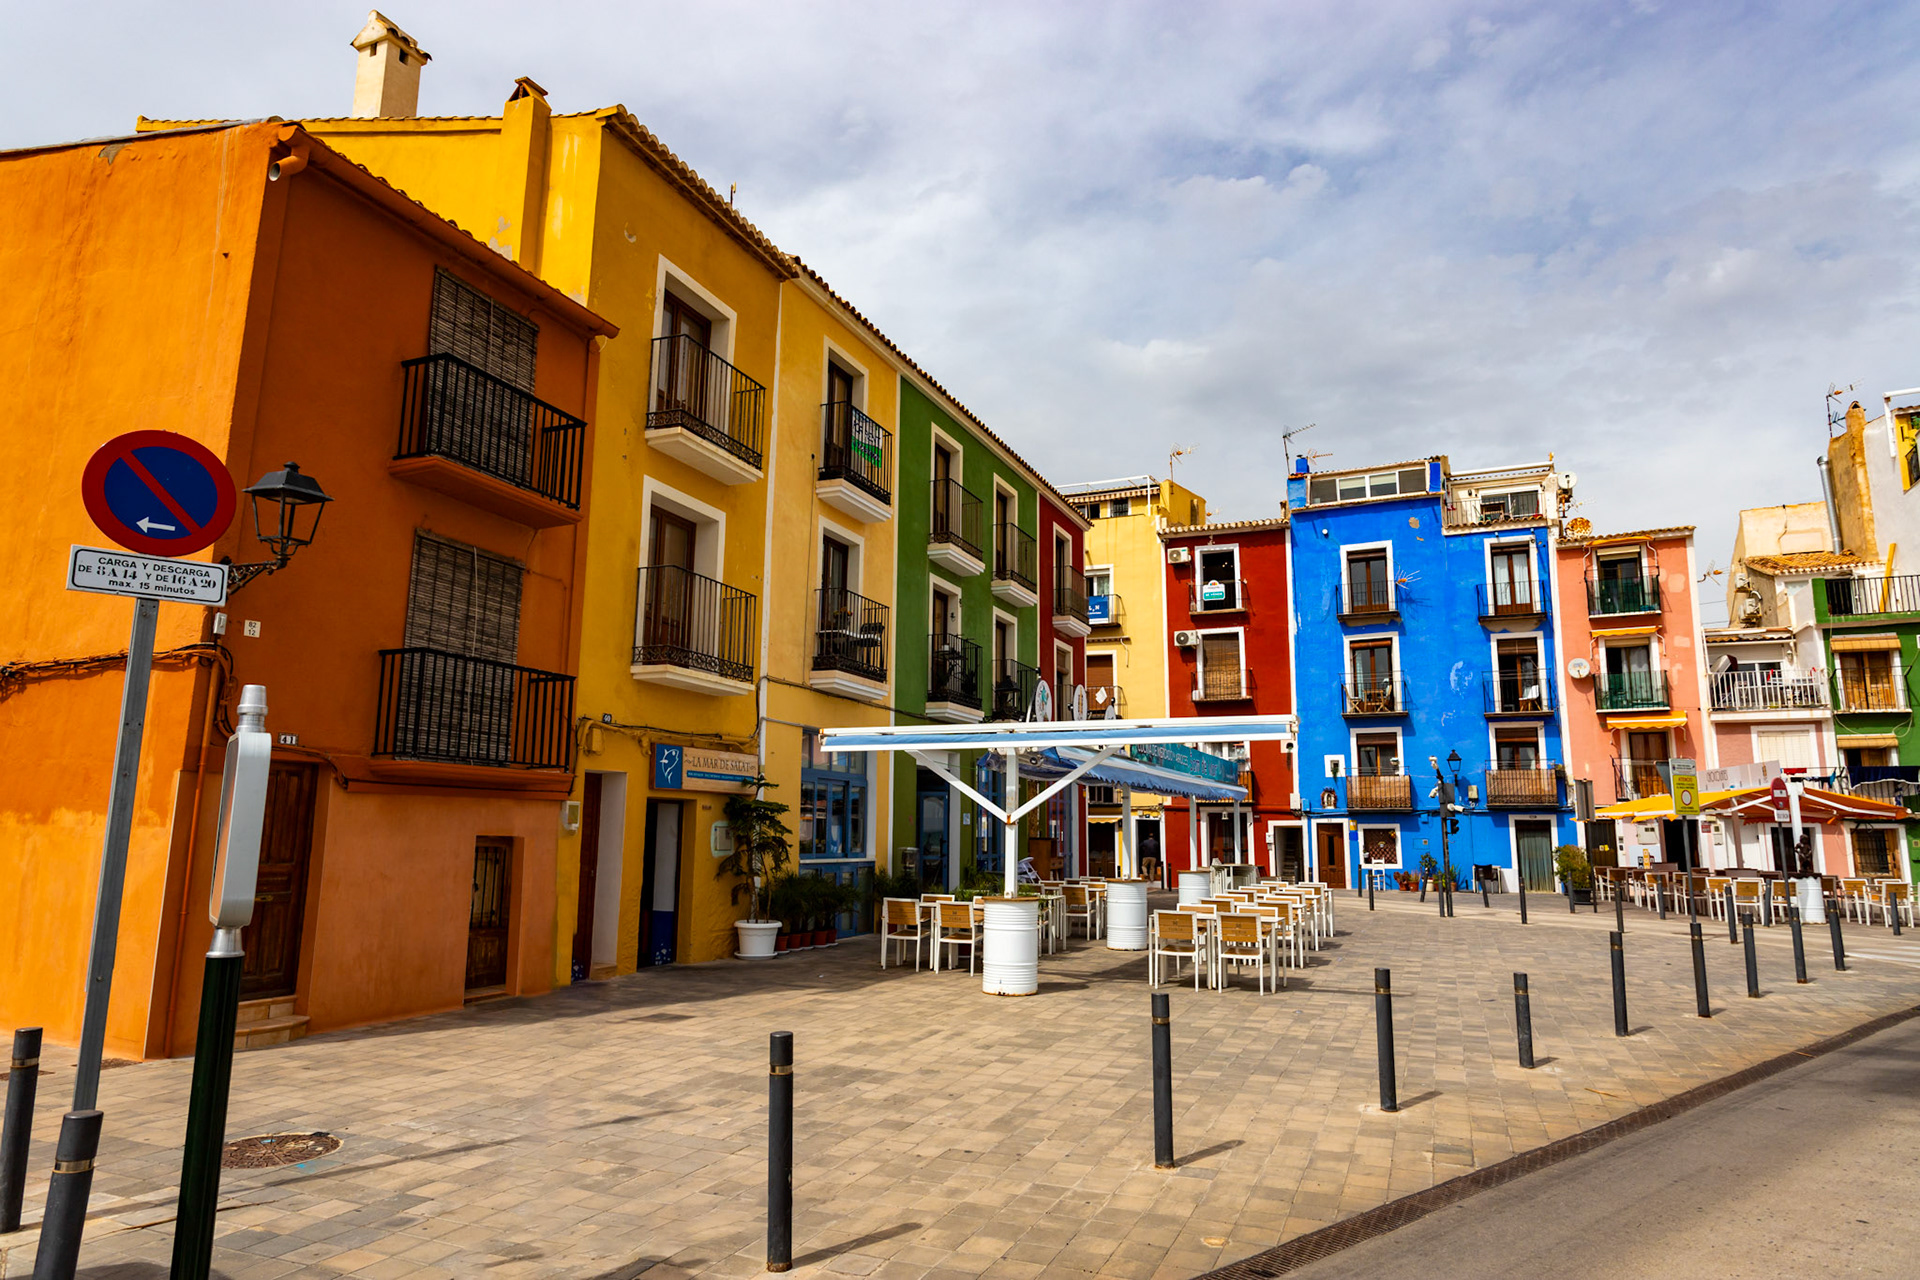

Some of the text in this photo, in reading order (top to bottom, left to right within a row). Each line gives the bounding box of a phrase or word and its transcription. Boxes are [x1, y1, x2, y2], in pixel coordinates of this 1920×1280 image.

[78, 564, 217, 589] DE 8 A 14 Y DE 16 A 20
[98, 556, 210, 578] CARGA Y DESCARGA
[108, 579, 195, 596] max. 15 minutos
[692, 756, 750, 772] LA MAR DE SALAT
